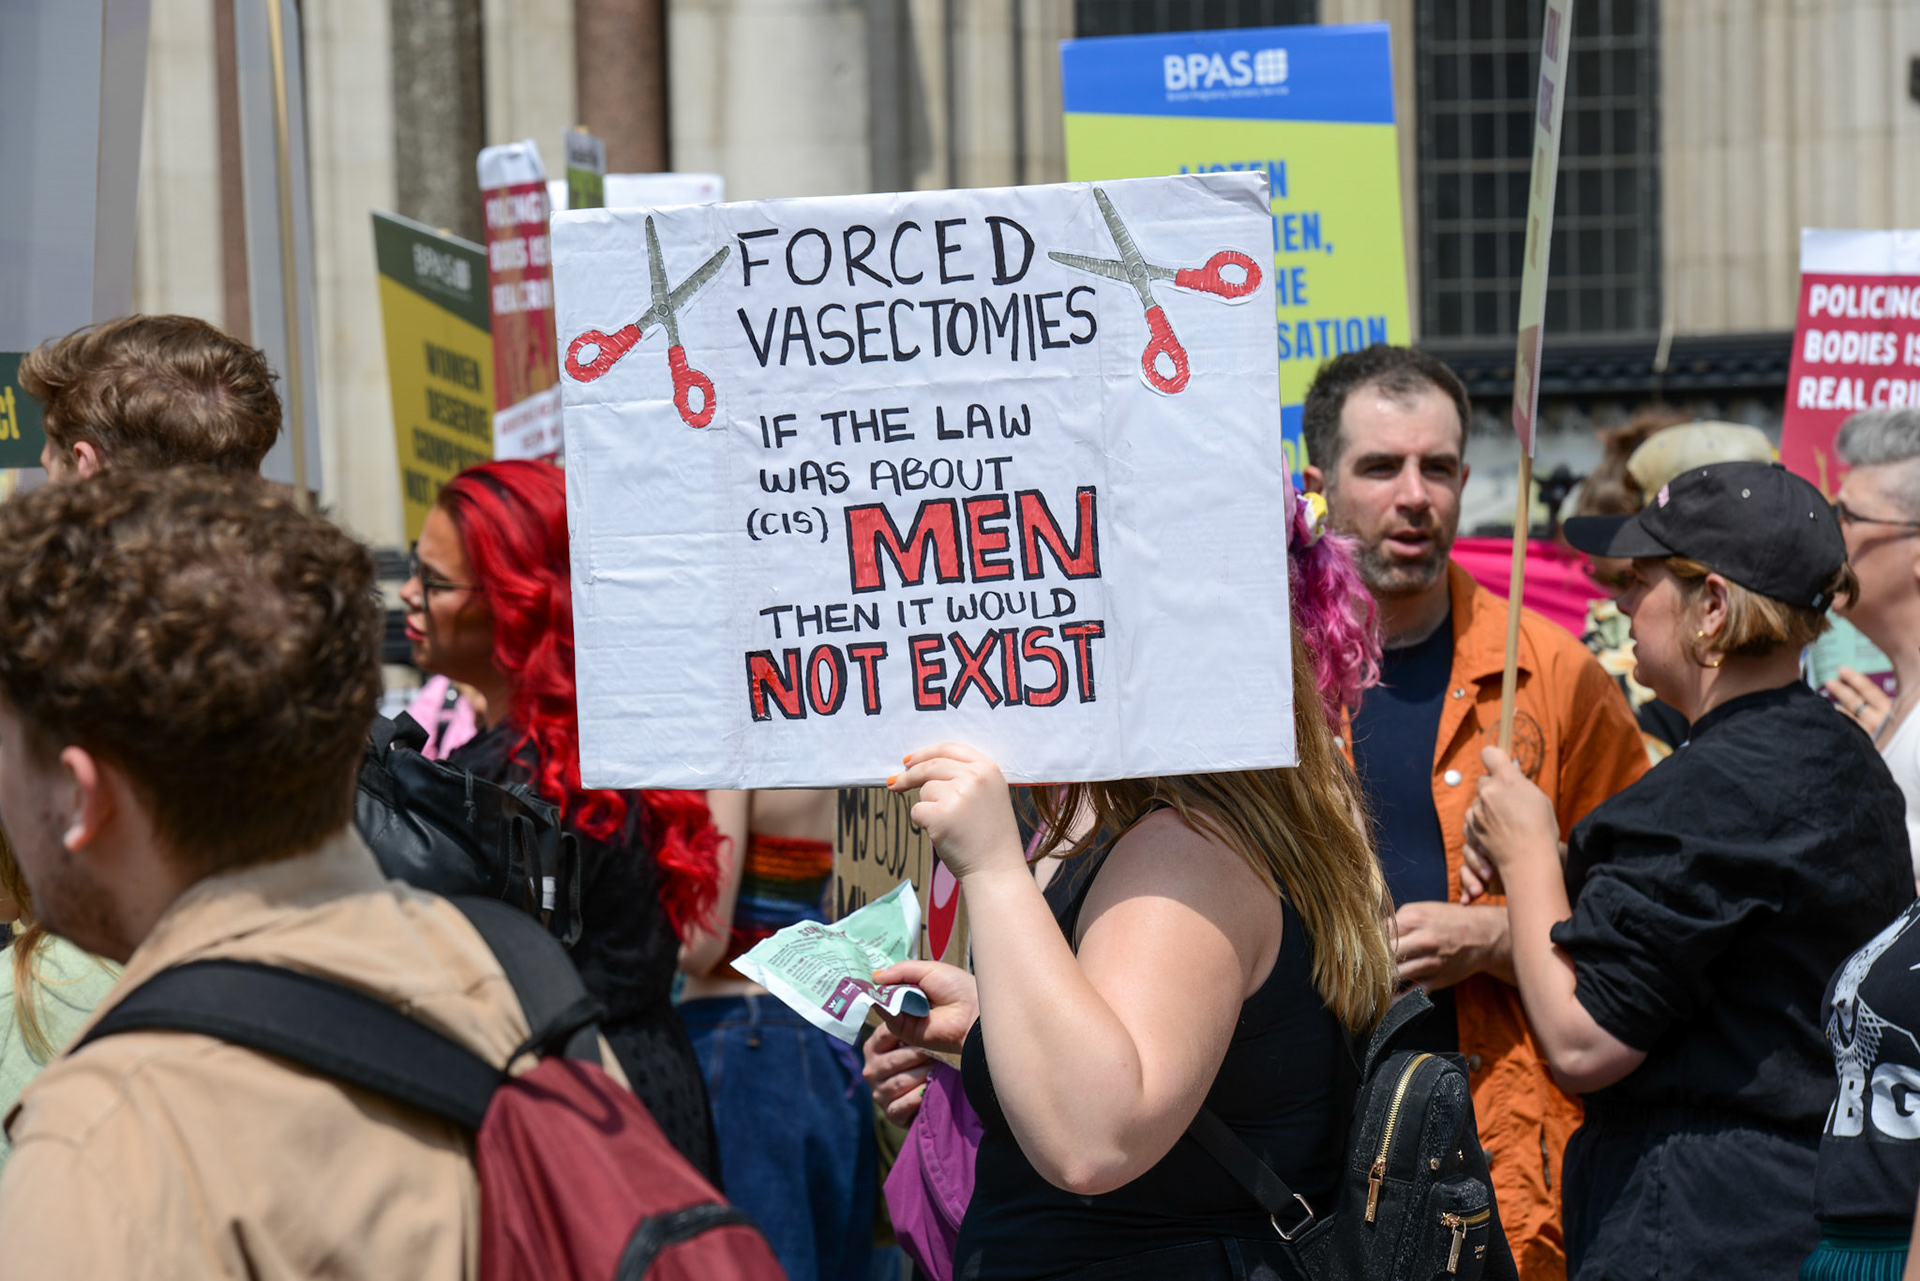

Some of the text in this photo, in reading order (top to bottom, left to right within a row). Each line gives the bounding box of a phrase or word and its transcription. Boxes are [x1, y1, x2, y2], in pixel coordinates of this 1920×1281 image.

[1163, 51, 1253, 91] BPAS
[737, 216, 1035, 288] FORCED
[737, 285, 1098, 368] VASECTOMIES
[1802, 328, 1898, 366] BODIES
[1796, 376, 1868, 411] REAL
[759, 403, 1031, 448] IF THE LAW
[759, 456, 1013, 496] WAS ABOUT
[844, 485, 1101, 595] MEN
[759, 587, 1076, 639] THEN IT WOULD
[745, 619, 1106, 722] NOT EXIST
